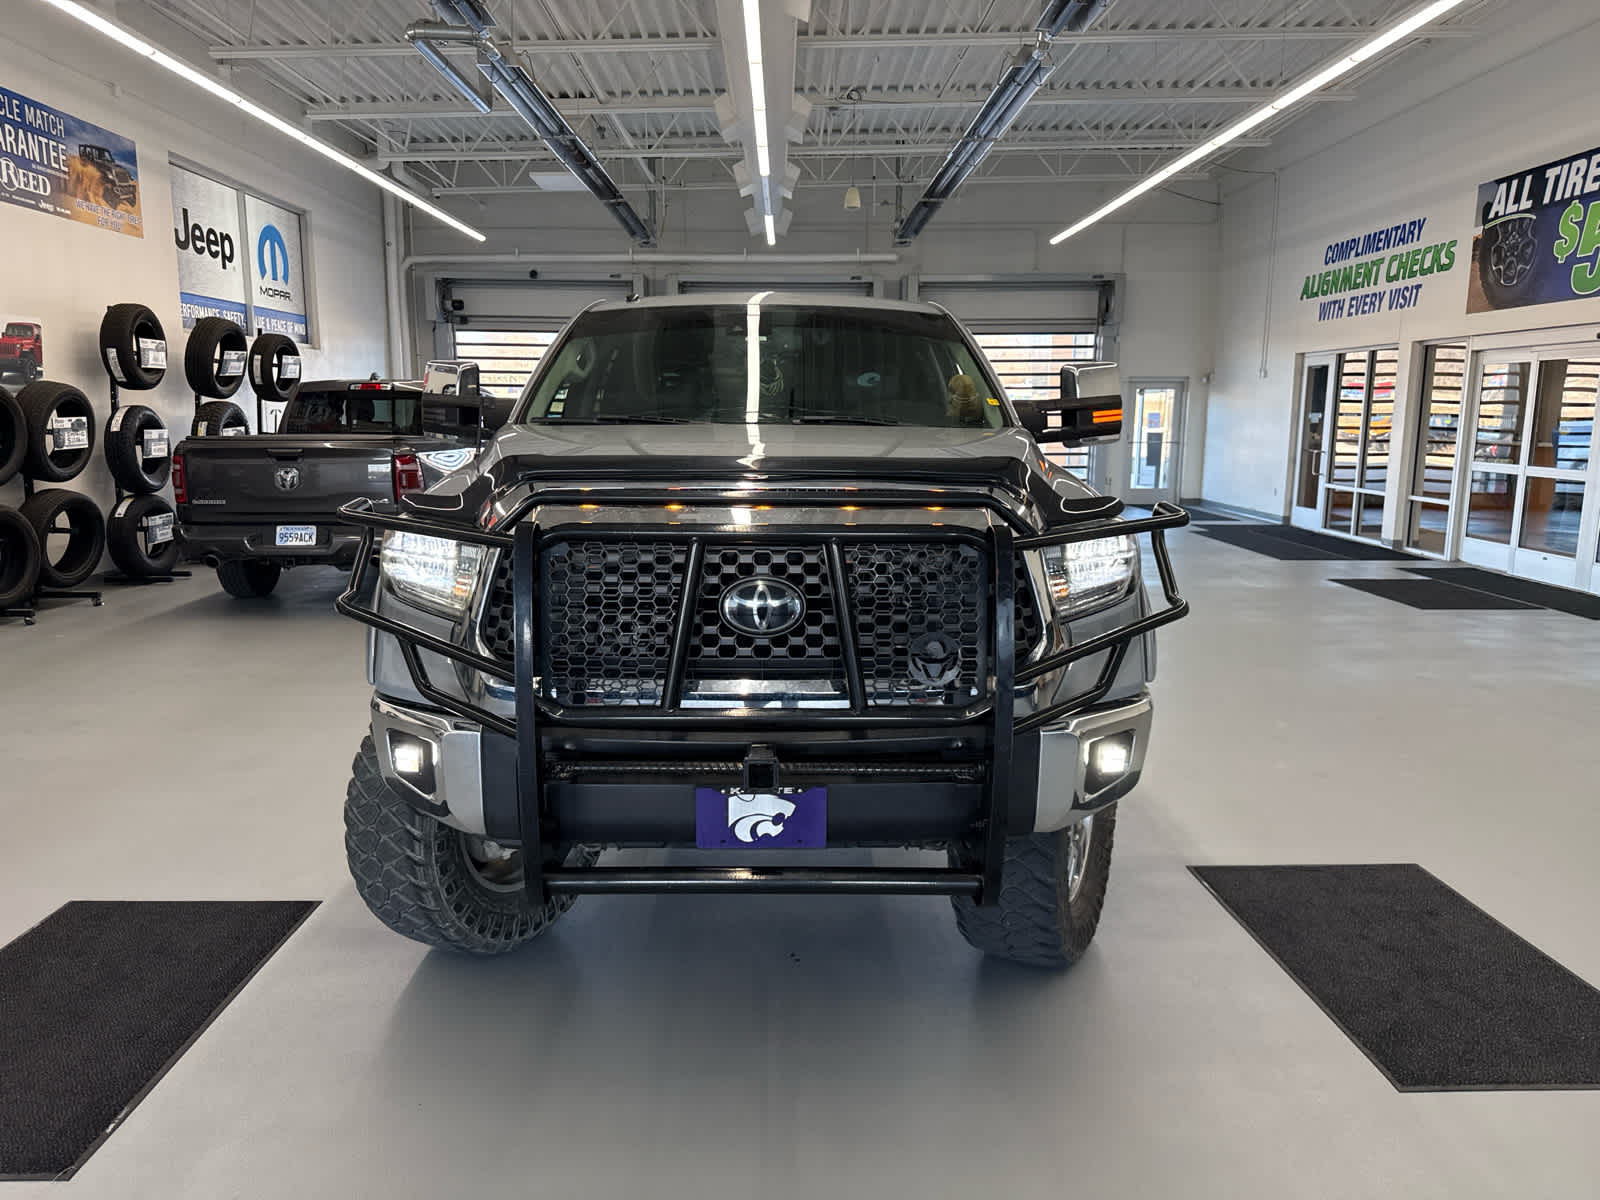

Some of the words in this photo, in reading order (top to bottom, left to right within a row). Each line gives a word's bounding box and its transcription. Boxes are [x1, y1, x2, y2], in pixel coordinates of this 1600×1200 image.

[24, 103, 65, 139] MATCH
[1487, 174, 1534, 220] ALL
[174, 207, 235, 270] Jeep
[1324, 217, 1427, 266] COMPLIMENTARY
[259, 285, 291, 301] MOPAR
[1300, 257, 1386, 301] ALIGNMENT
[1385, 239, 1458, 284] CHECKS
[1318, 297, 1346, 322] WITH
[1346, 290, 1387, 318] EVERY
[1388, 283, 1423, 311] VISIT
